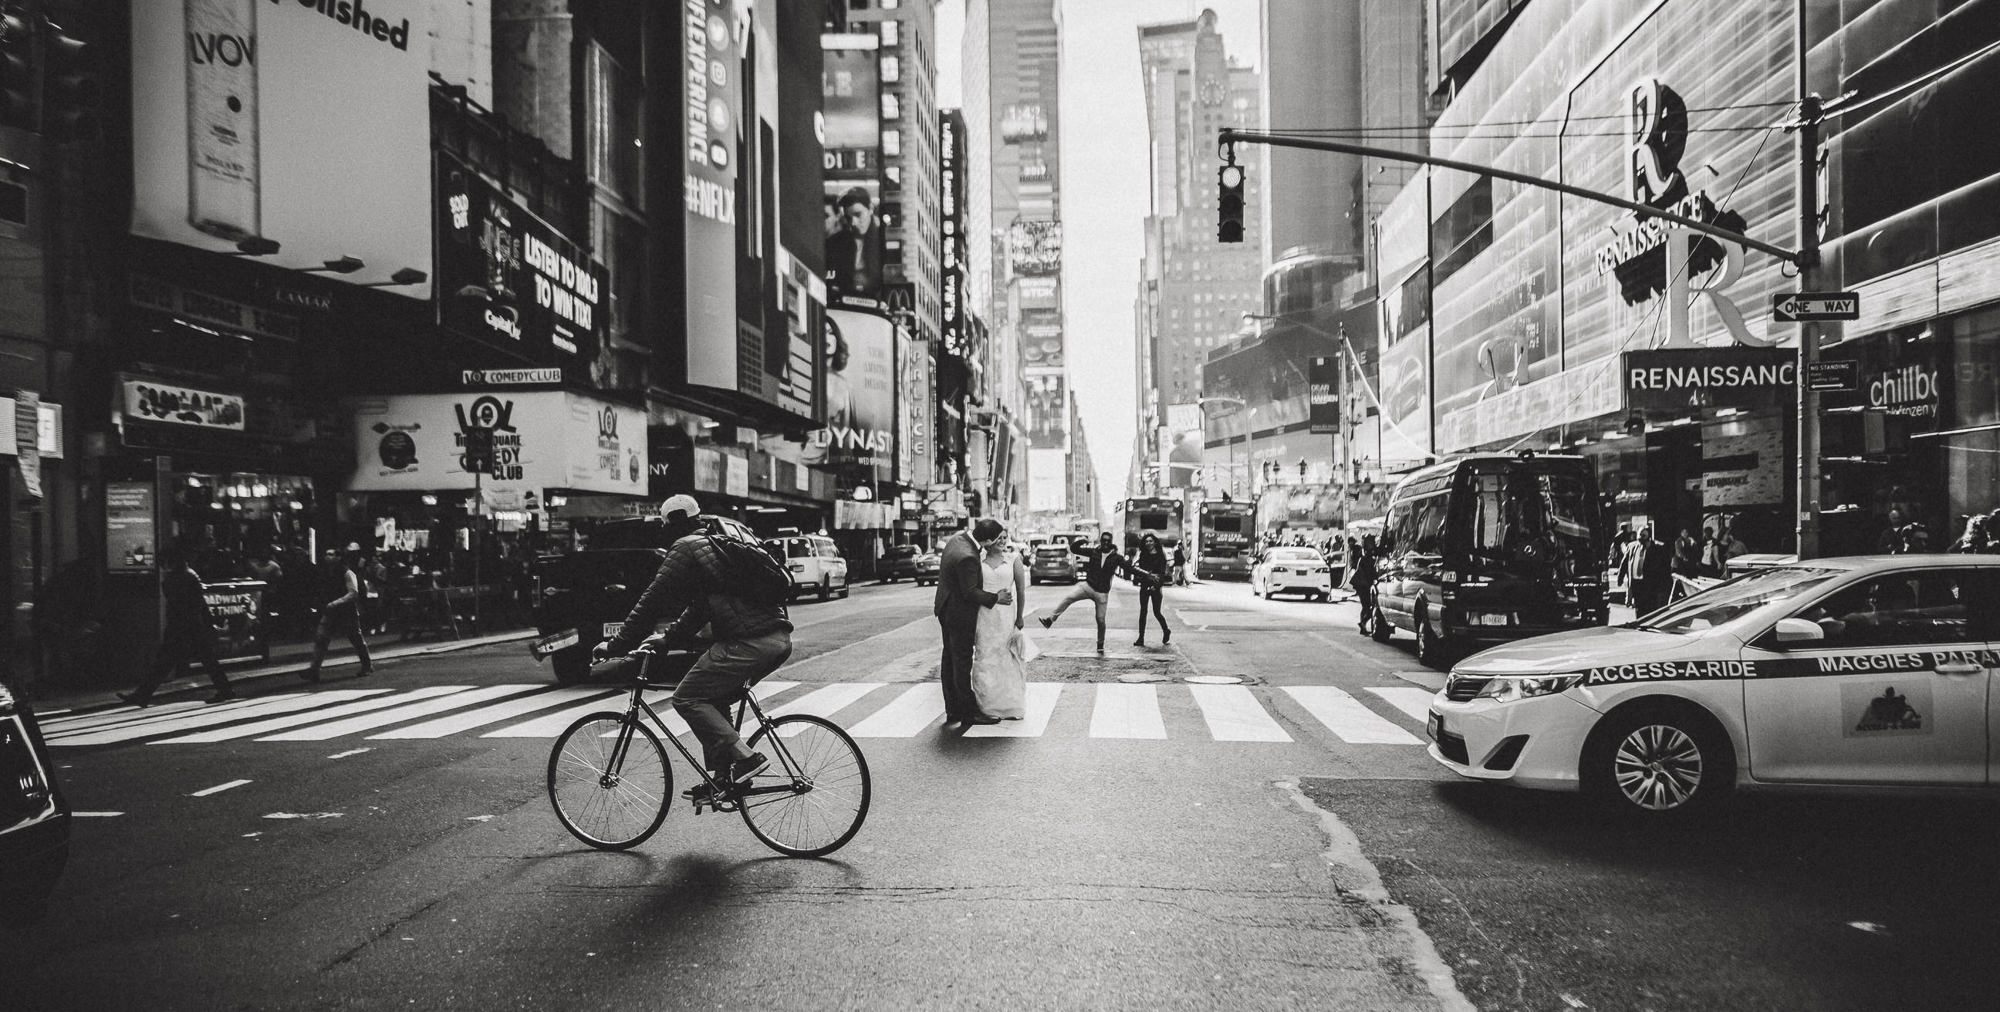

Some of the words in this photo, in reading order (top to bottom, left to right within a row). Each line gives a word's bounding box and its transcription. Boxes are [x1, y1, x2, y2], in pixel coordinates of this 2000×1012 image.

[687, 0, 708, 167] FLEXPERIENCE
[524, 232, 560, 280] LISTEN
[560, 256, 575, 289] TO
[534, 273, 552, 309] TO
[552, 284, 574, 321] WIN
[1785, 302, 1811, 313] ONE
[1824, 300, 1852, 312] WAY
[1631, 364, 1796, 390] RENAISSANC
[492, 465, 523, 481] CLUB
[1589, 661, 1757, 684] ACCESS-A-RIDE
[1818, 653, 1924, 673] MAGGIES
